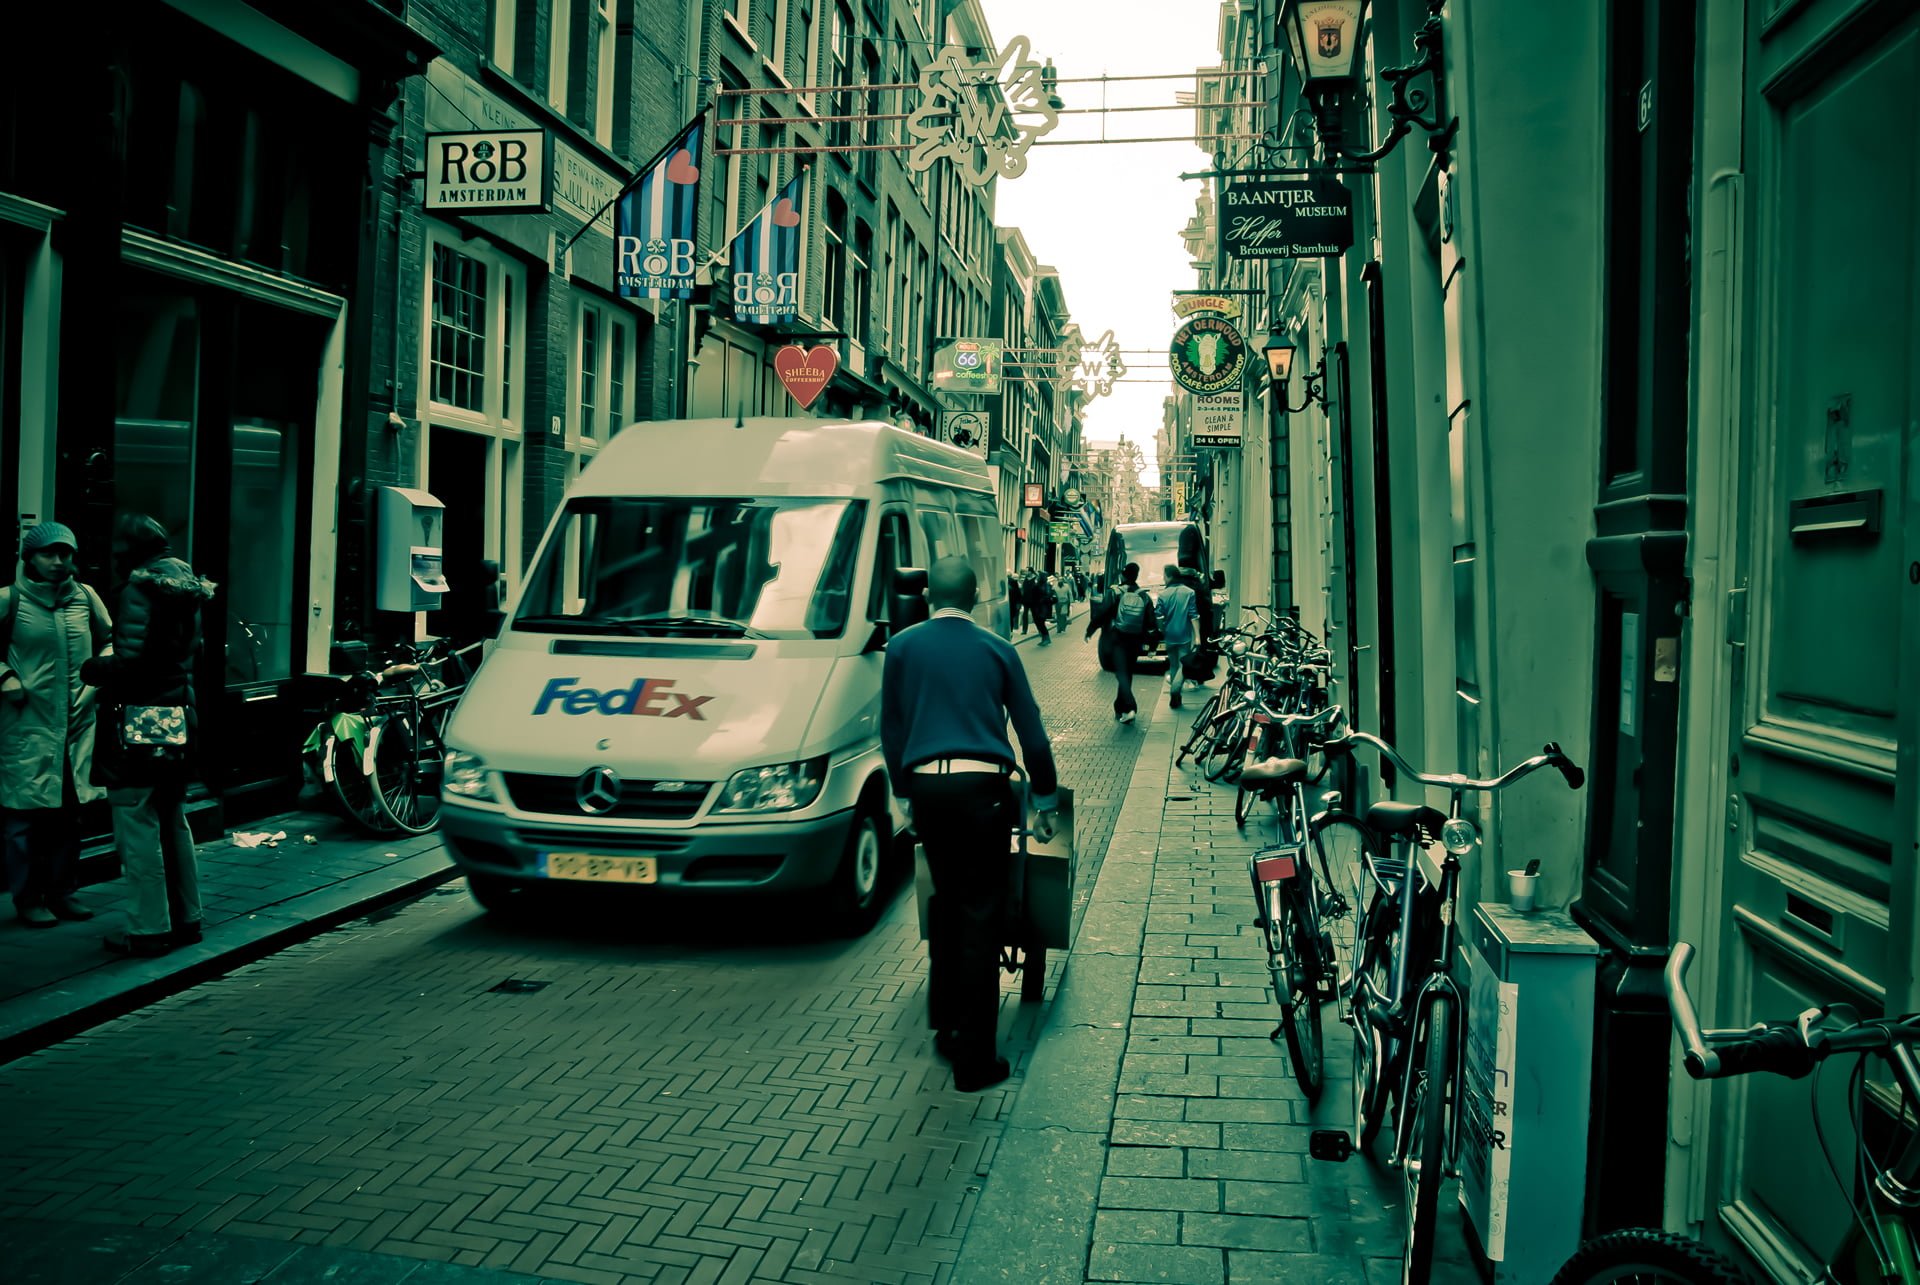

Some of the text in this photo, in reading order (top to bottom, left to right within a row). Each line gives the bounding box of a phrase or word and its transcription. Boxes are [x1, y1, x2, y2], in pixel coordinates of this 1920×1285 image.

[439, 188, 527, 203] AMSTERDAM
[1227, 189, 1317, 208] BAANTJER
[1295, 206, 1347, 217] MUSEUM
[1225, 215, 1282, 247] Heffer
[1239, 243, 1339, 257] Brouwerij Stamhuis
[618, 276, 695, 290] AMSTERDAM
[1181, 298, 1225, 313] JUNGLE
[1176, 319, 1242, 346] HET OERWOUD
[958, 352, 977, 366] 66
[1171, 353, 1183, 376] POOL
[785, 367, 825, 378] SHEEBA
[1182, 361, 1233, 382] AMSTERDAM
[1197, 396, 1240, 405] ROOMS
[1205, 415, 1227, 424] CLEAN
[1207, 423, 1232, 433] SIMPLE
[531, 677, 716, 721] FedEx
